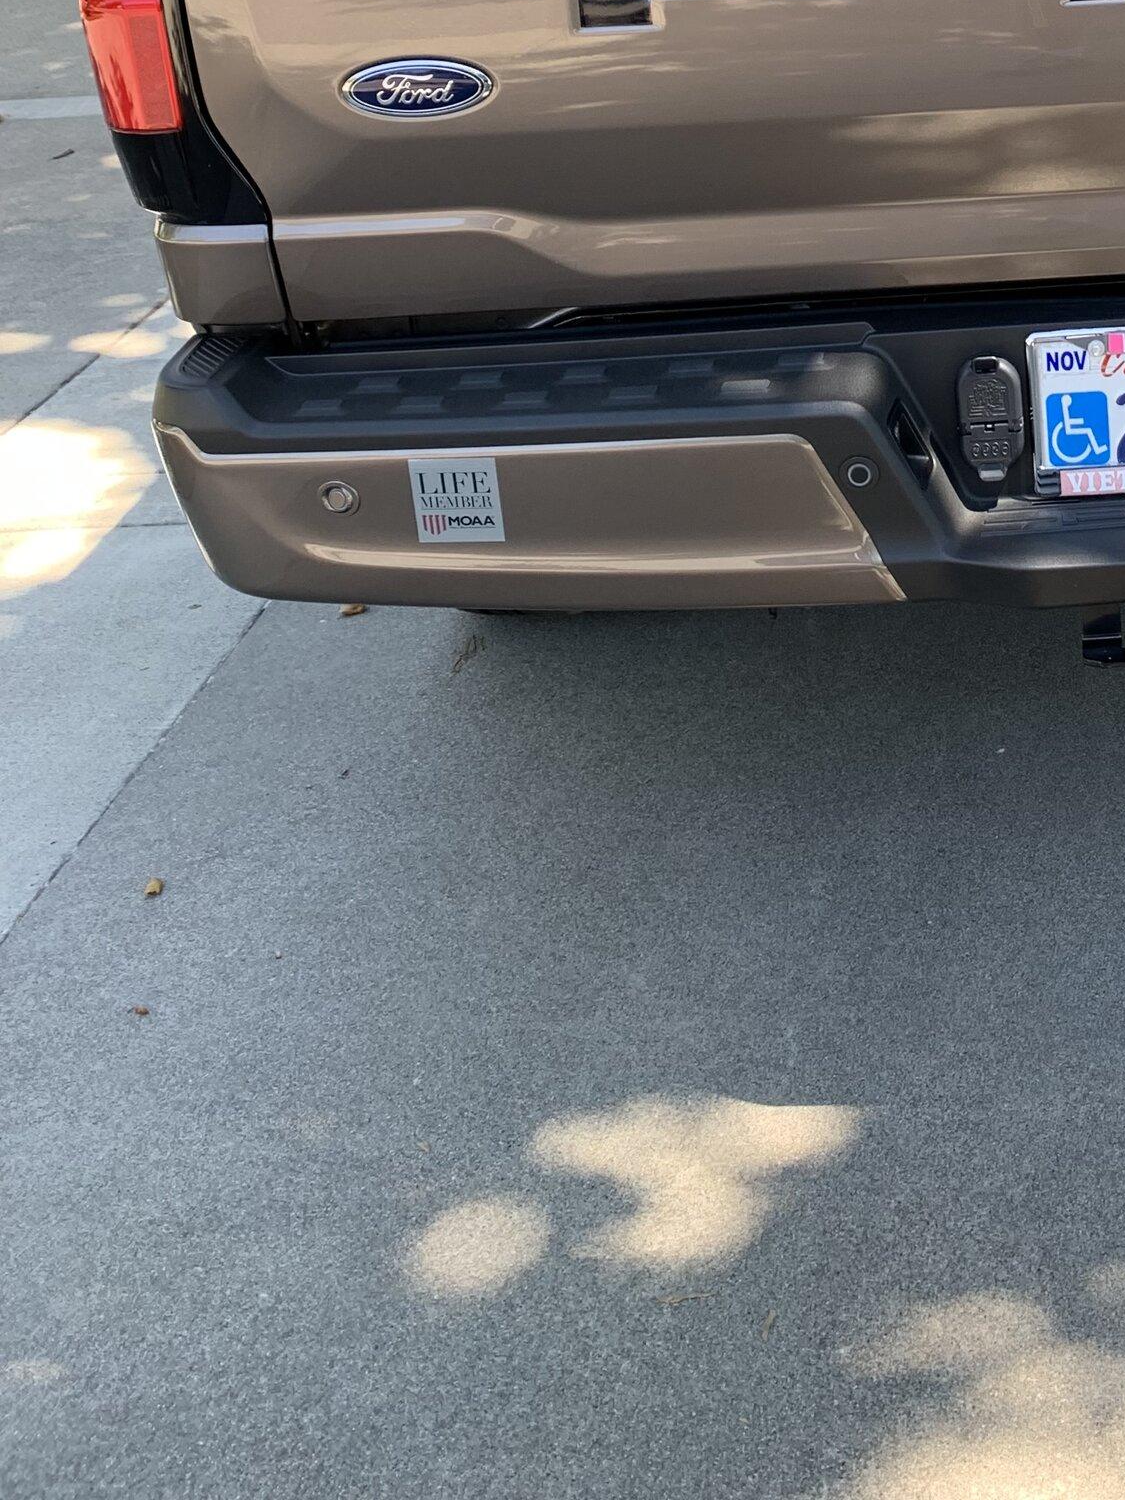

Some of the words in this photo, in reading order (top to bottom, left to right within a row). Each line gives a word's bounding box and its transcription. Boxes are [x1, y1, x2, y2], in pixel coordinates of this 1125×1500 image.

[376, 74, 454, 105] Ford
[1046, 351, 1087, 372] NOV
[416, 472, 491, 494] LIFE
[421, 496, 493, 508] MEMBER
[448, 516, 495, 526] MOAA
